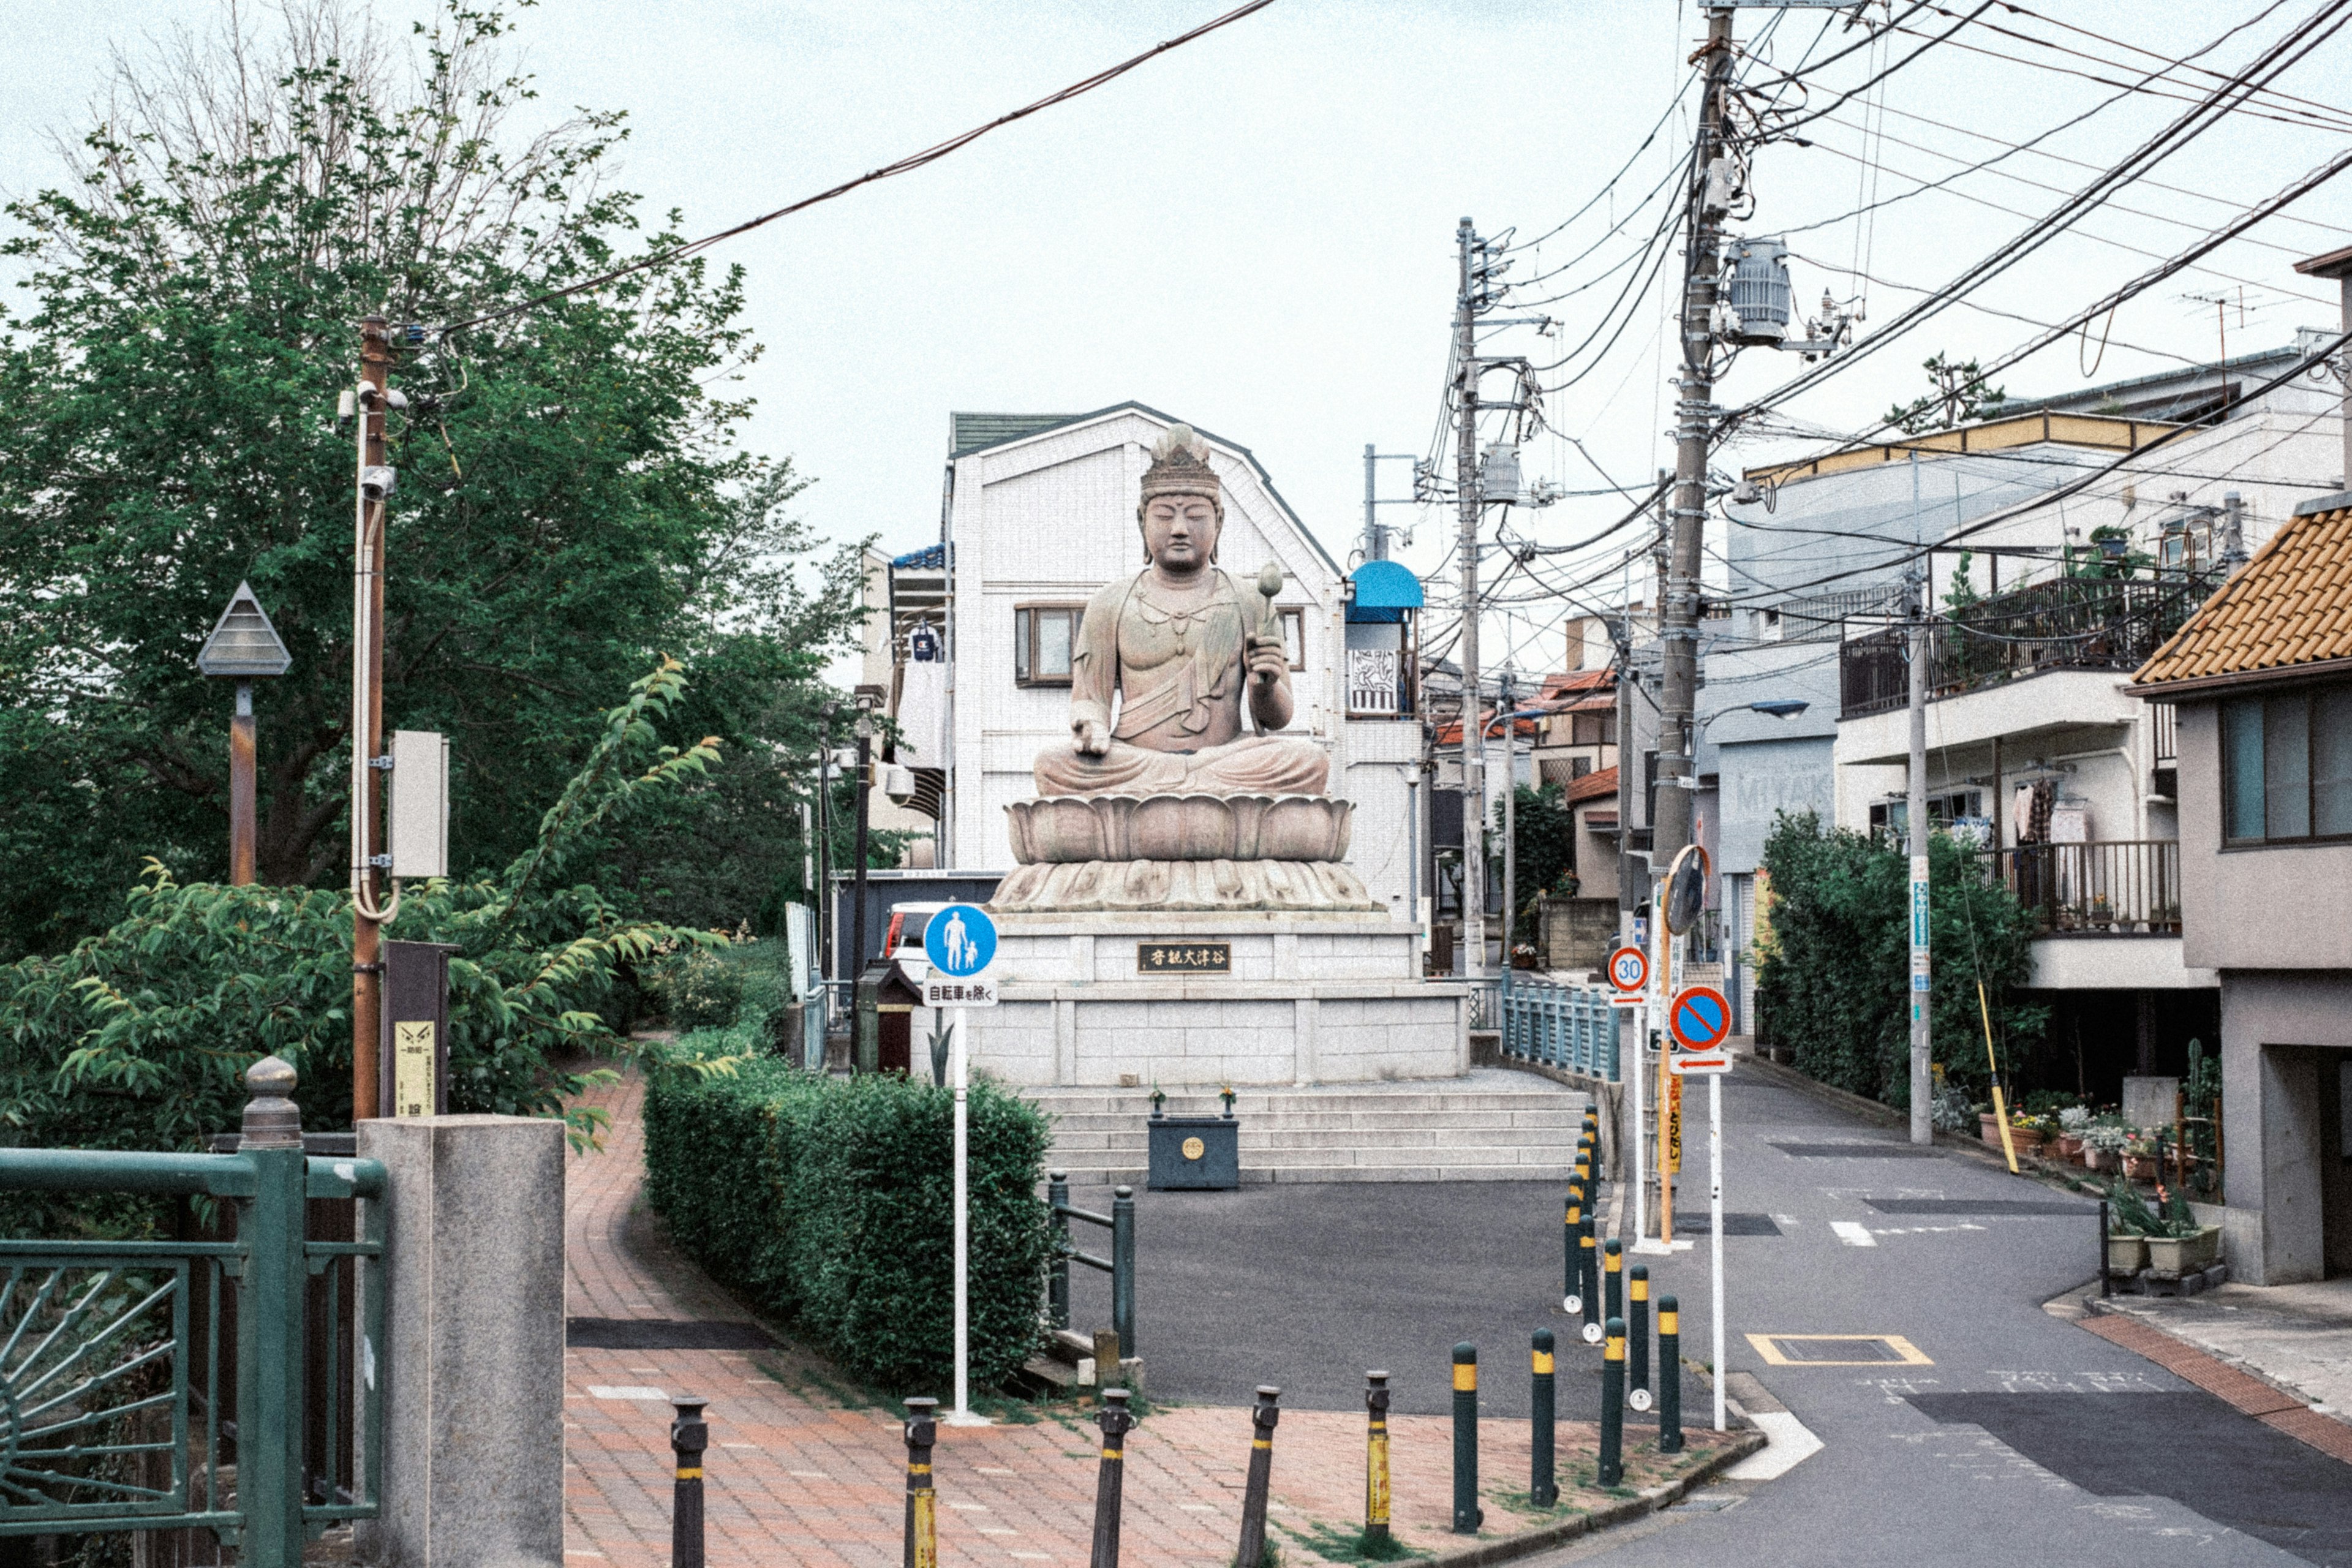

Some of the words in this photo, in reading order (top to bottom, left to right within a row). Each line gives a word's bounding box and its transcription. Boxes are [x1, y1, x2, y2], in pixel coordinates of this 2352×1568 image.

[1618, 960, 1640, 979] 30
[929, 985, 992, 1001] 自転車を除く
